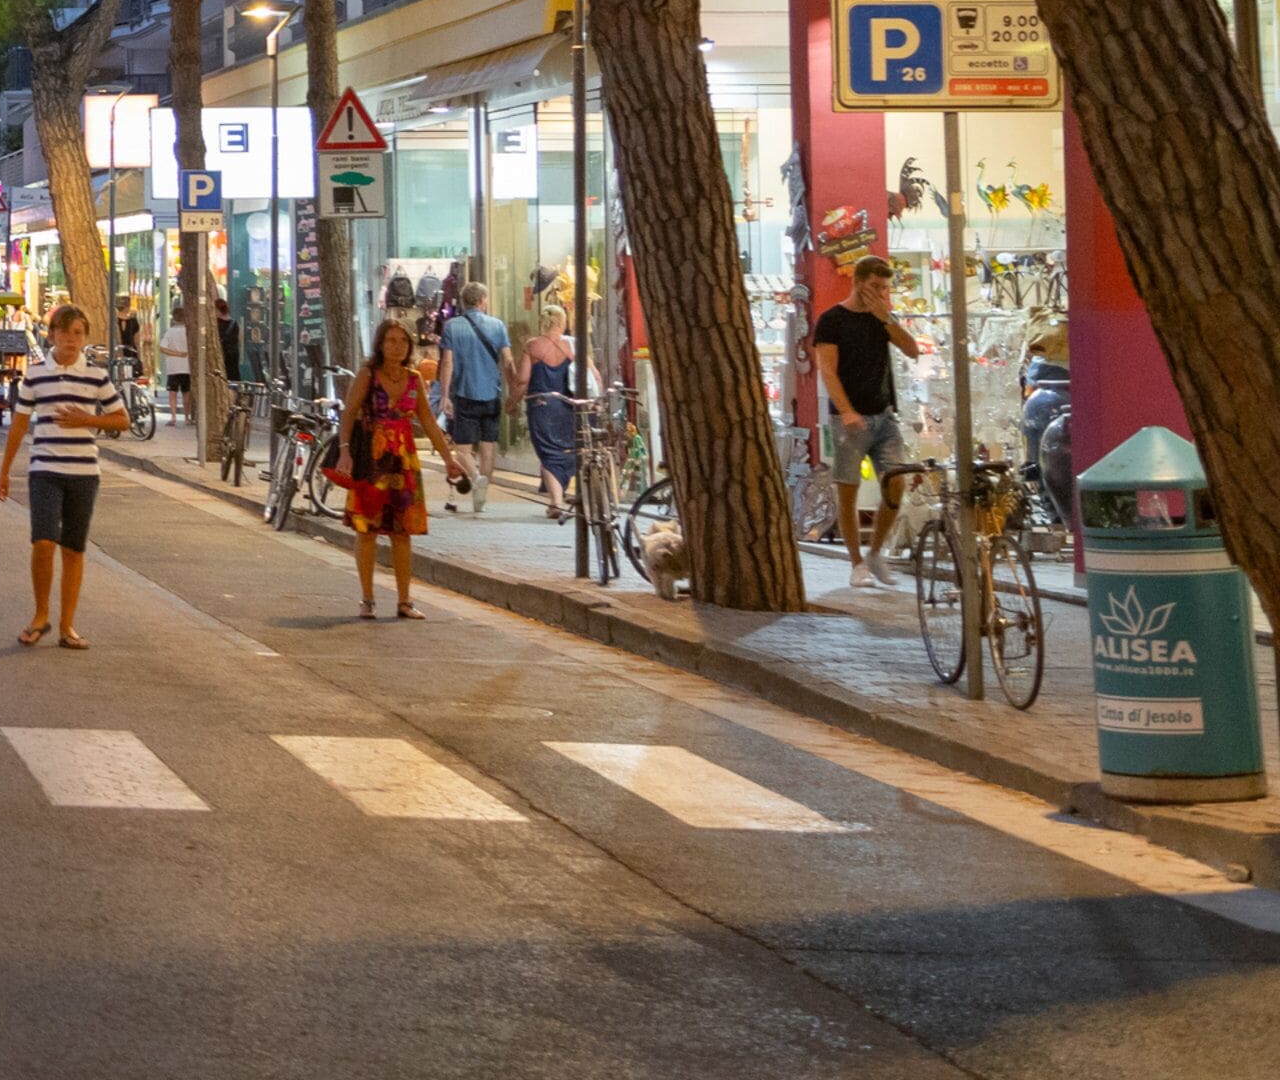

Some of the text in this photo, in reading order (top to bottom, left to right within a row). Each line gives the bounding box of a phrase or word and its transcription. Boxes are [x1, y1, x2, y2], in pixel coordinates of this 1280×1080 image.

[1003, 15, 1039, 28] 9.00
[992, 31, 1039, 43] 20.00
[870, 17, 927, 82] P 26
[968, 58, 1010, 69] eccetto
[188, 174, 214, 206] P
[1095, 634, 1198, 663] ALISEA
[1144, 708, 1193, 727] Jesolo
